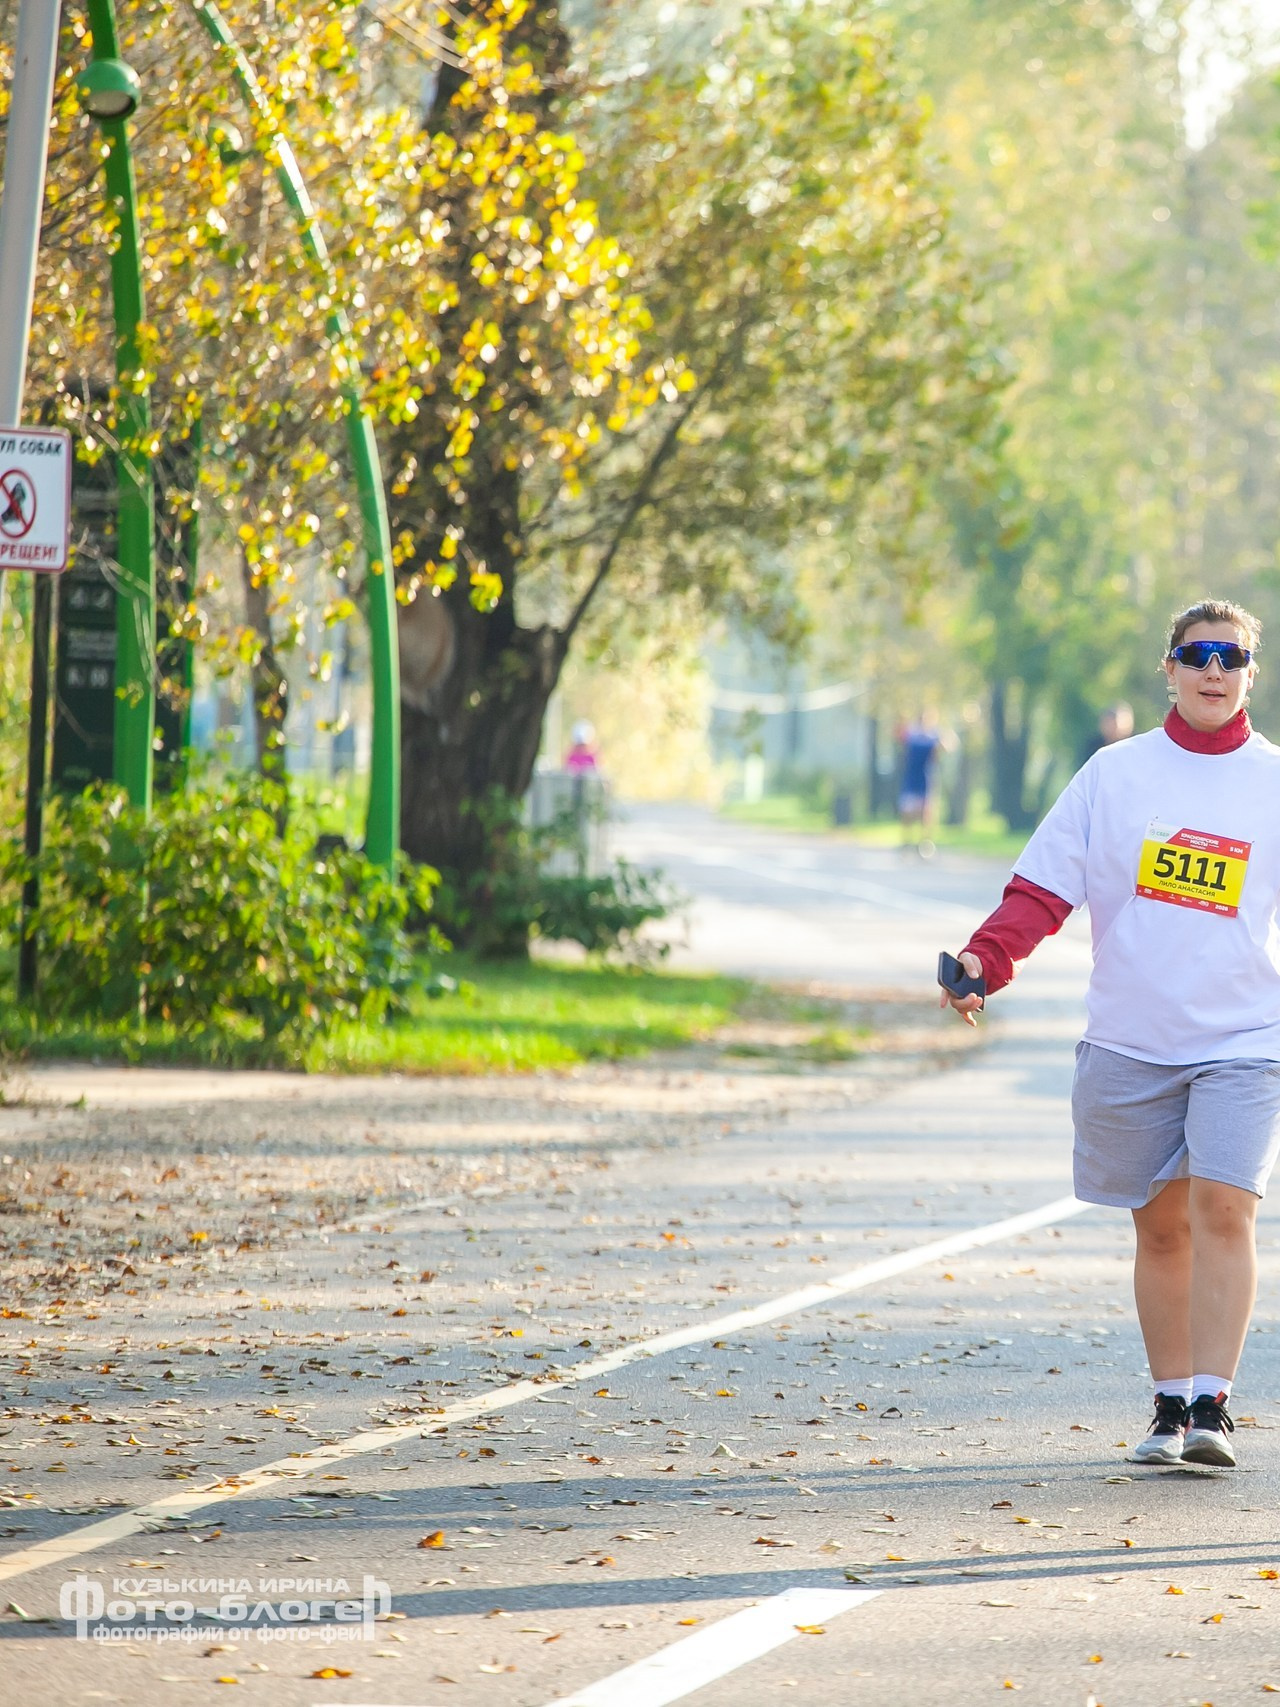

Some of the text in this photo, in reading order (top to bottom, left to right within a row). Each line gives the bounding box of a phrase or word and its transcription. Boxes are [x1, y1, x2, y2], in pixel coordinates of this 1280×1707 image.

[19, 440, 62, 456] СОБАК
[1153, 847, 1227, 891] 5111
[1158, 880, 1177, 889] ЛИЛО
[1177, 884, 1216, 897] АНАСТАСИЯ
